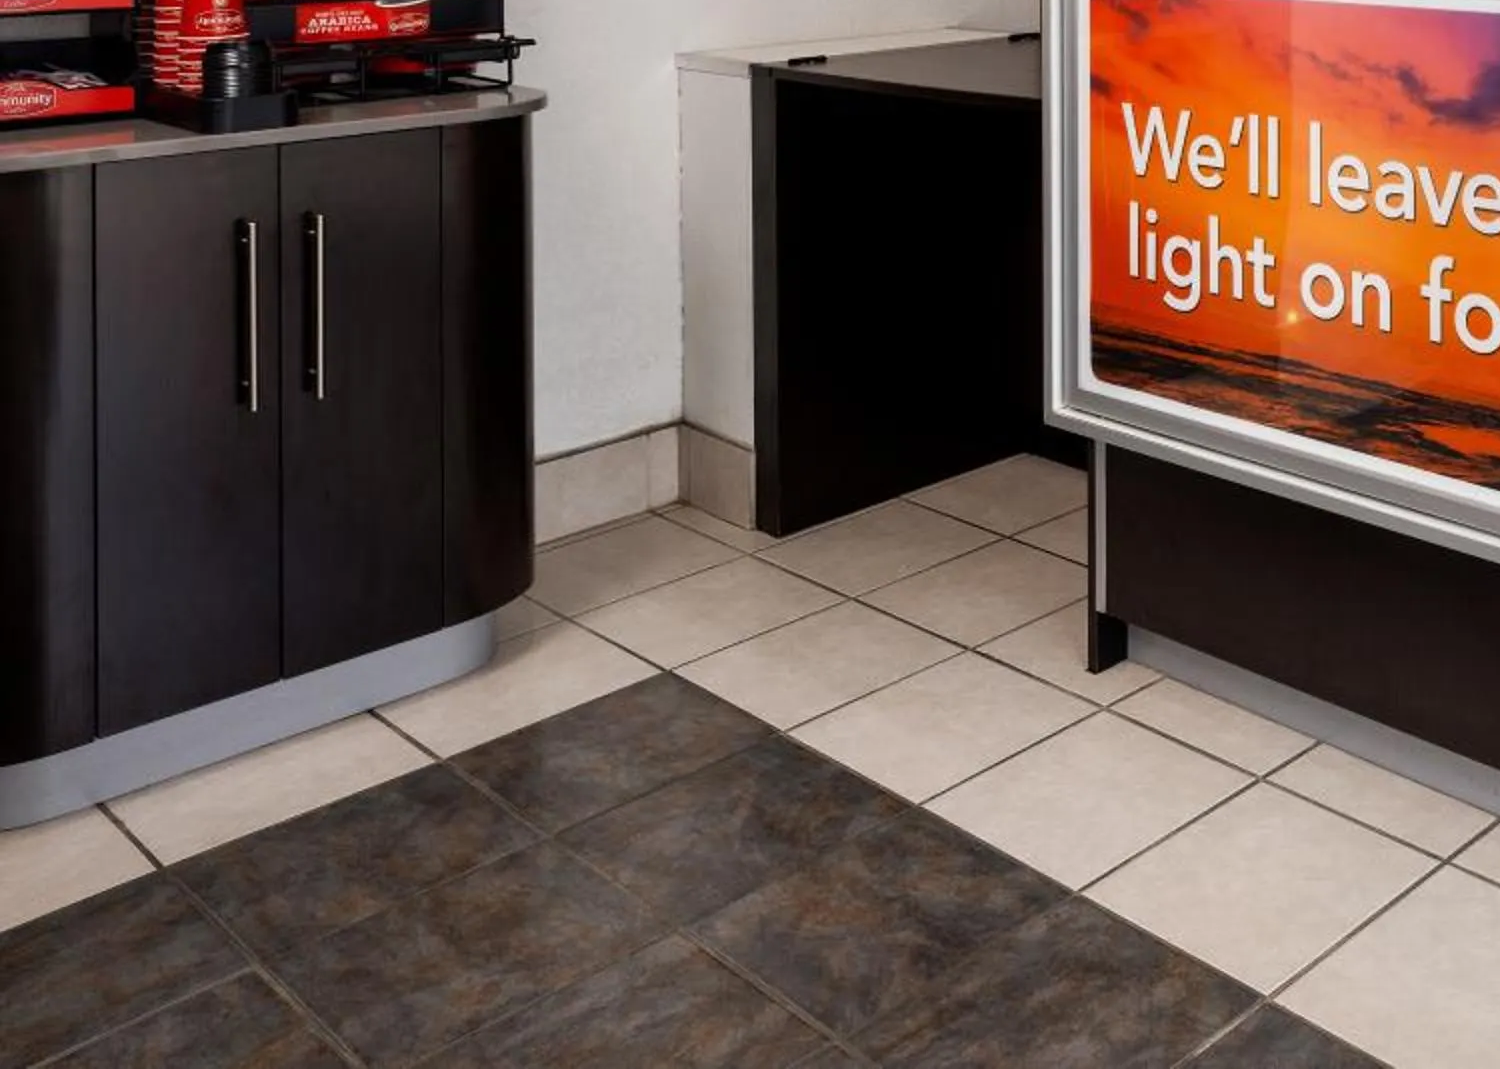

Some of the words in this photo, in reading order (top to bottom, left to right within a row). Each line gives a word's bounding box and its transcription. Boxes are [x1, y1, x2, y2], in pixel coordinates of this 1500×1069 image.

[1122, 103, 1279, 198] We'll
[1129, 202, 1276, 312] light
[1300, 262, 1392, 332] on
